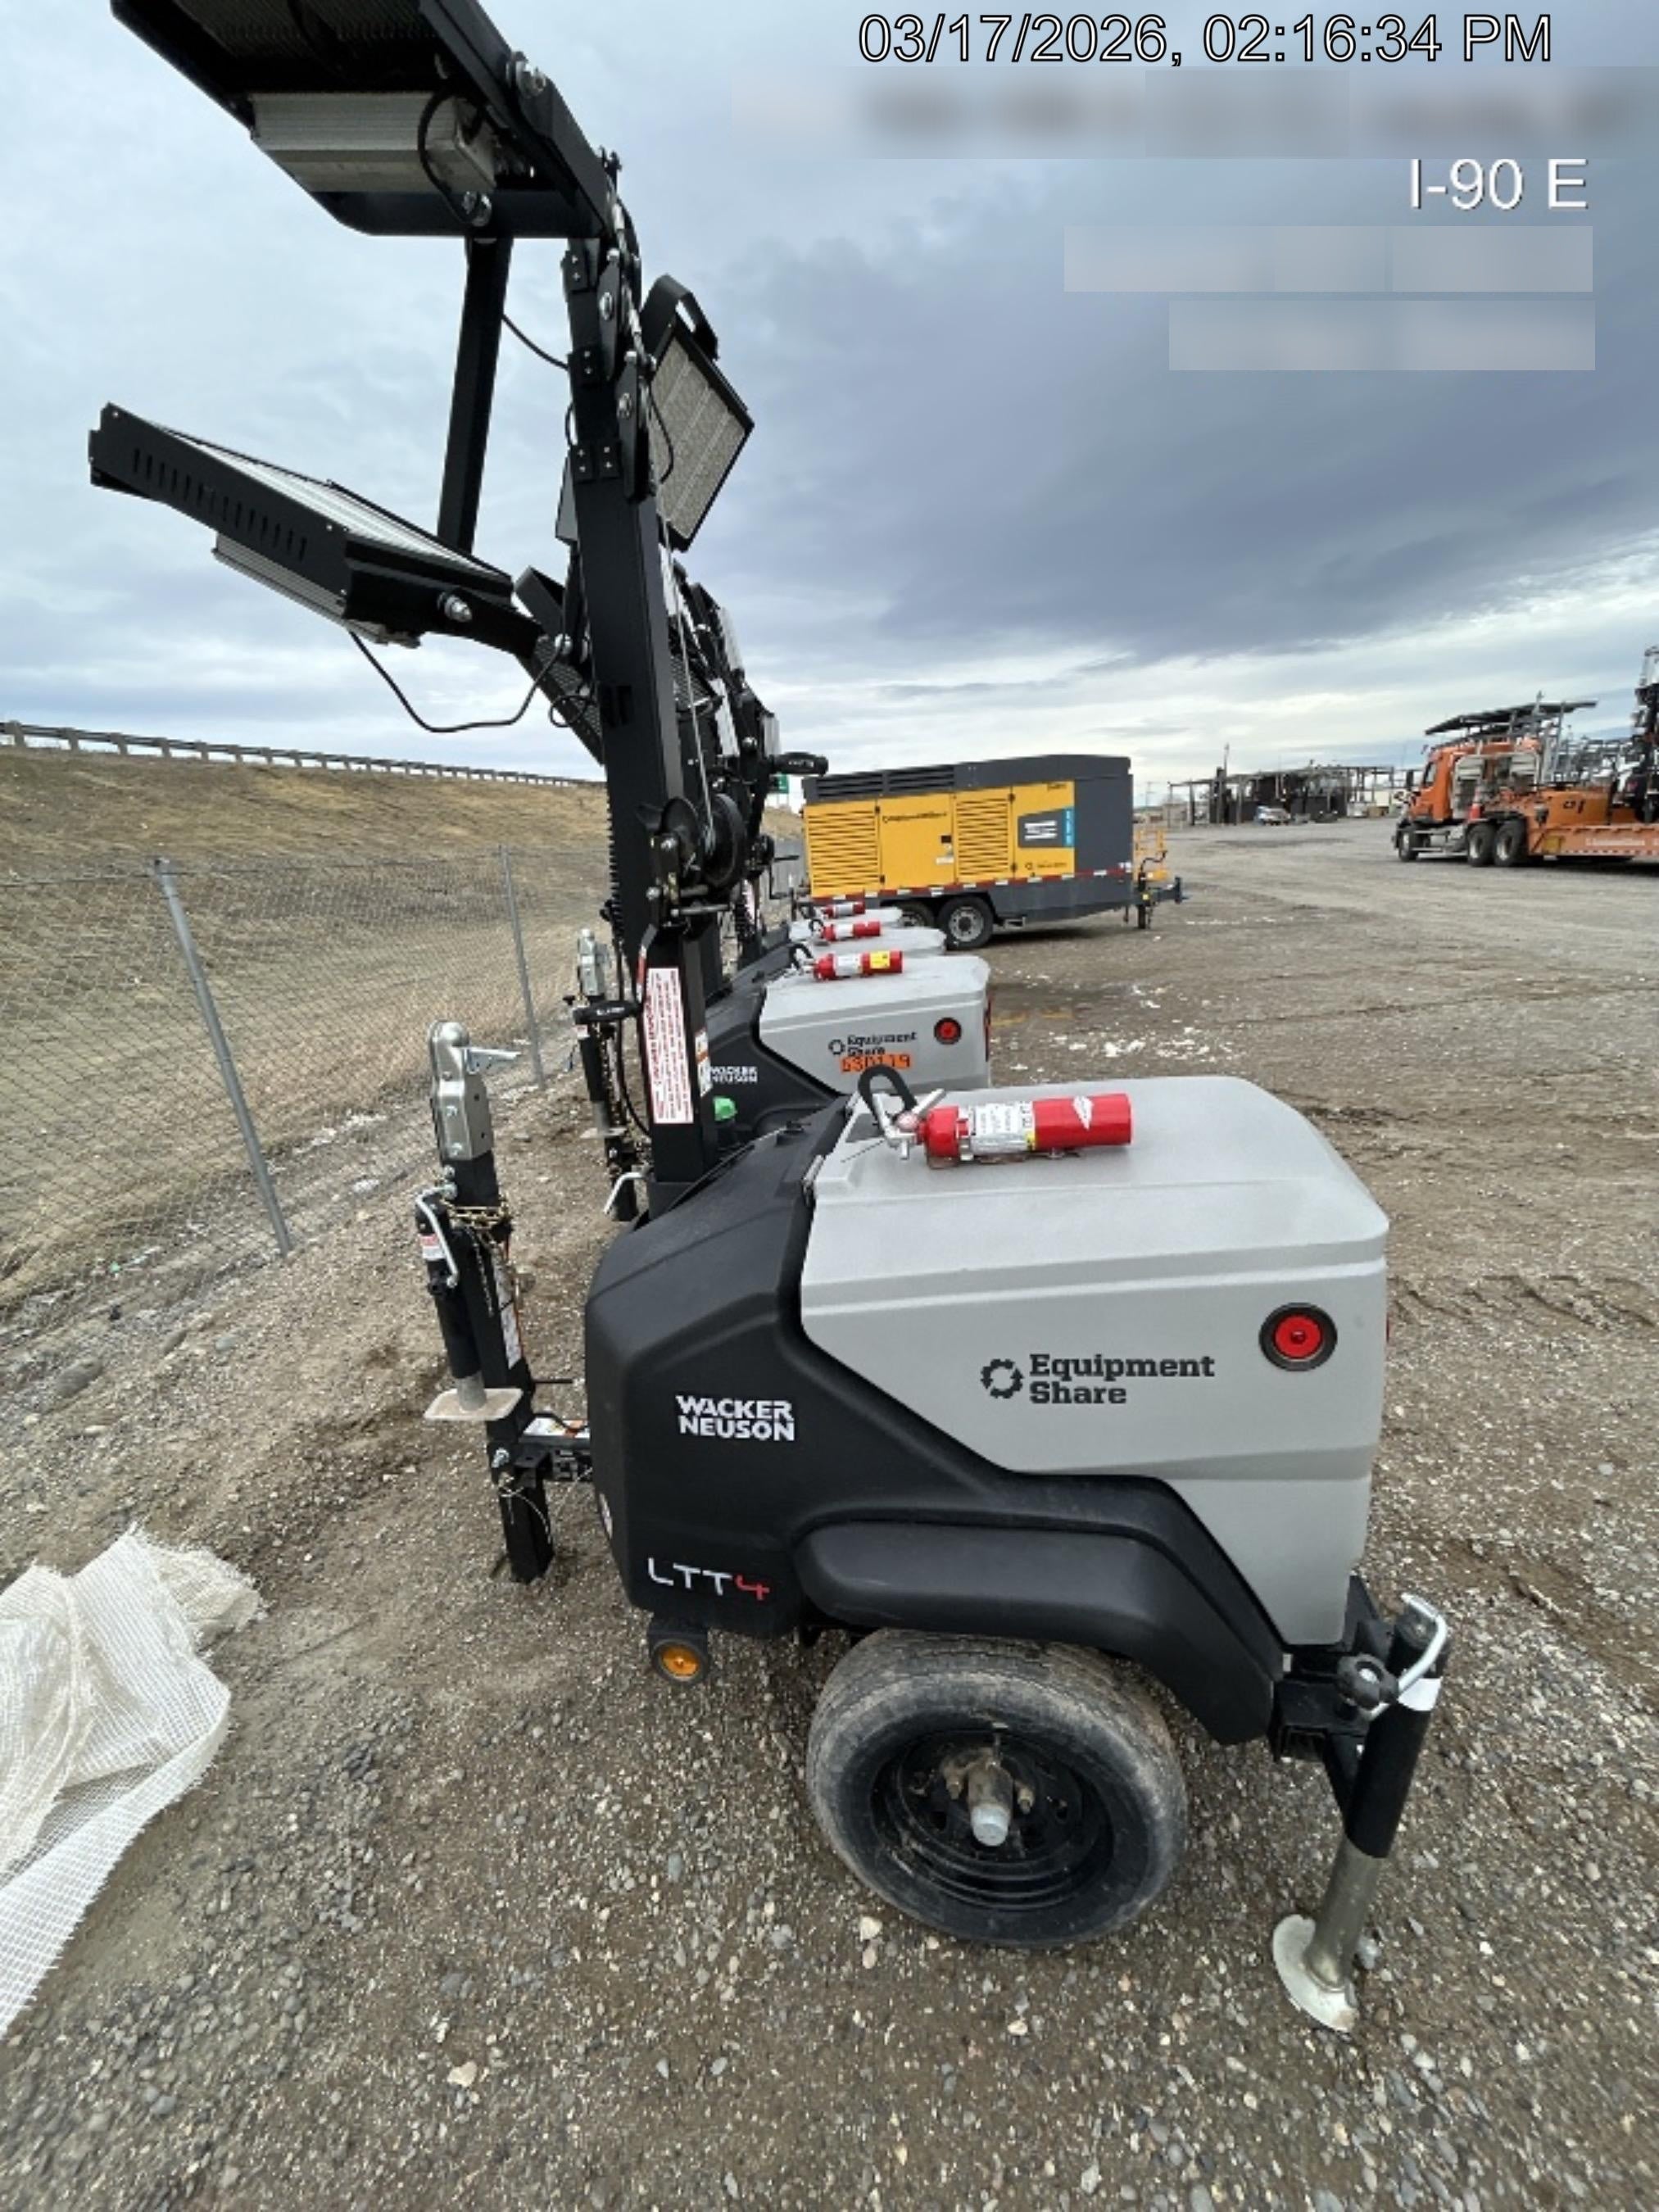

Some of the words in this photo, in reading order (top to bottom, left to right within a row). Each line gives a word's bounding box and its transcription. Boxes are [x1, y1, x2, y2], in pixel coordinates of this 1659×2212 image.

[1029, 1353, 1216, 1380] Equipment
[1029, 1381, 1127, 1405] Share
[675, 1394, 794, 1421] WACKER
[678, 1416, 796, 1442] NEUSON
[646, 1557, 771, 1602] LTT4
